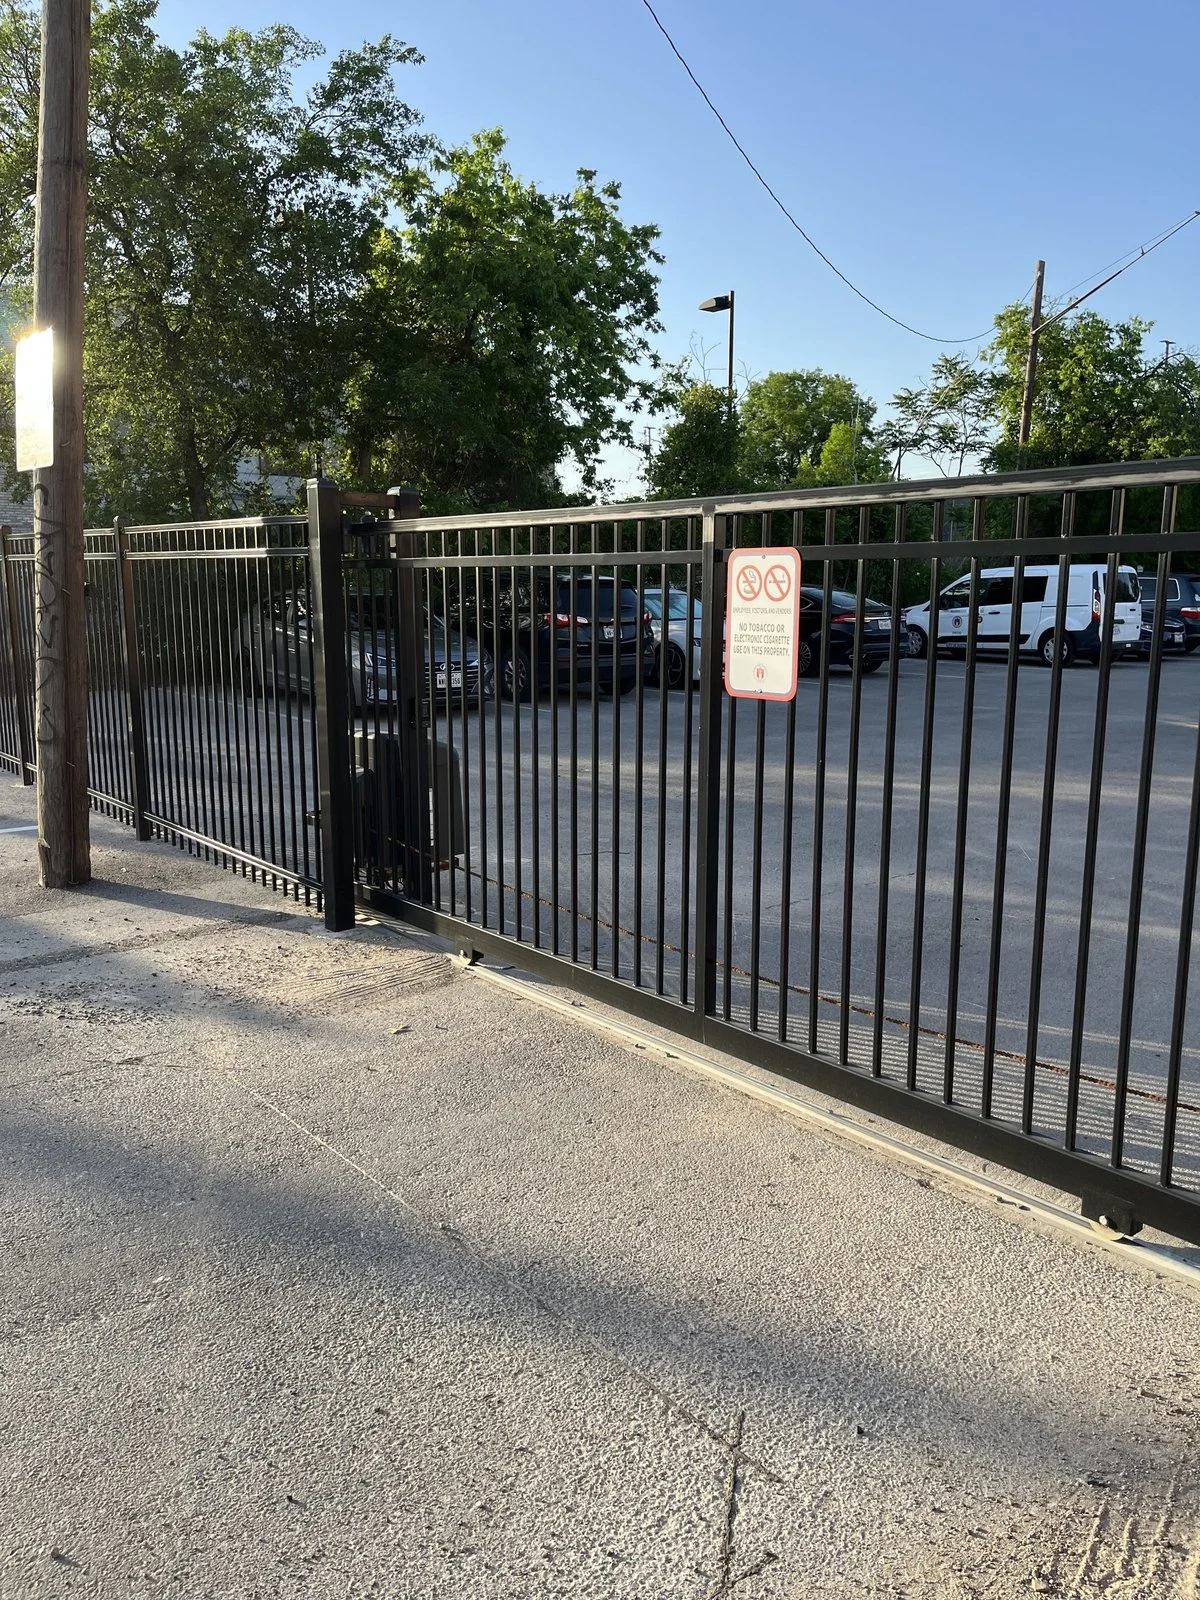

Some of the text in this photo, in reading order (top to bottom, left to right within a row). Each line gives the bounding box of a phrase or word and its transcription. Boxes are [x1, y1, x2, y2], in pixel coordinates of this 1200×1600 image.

[739, 622, 785, 633] NO TOBACCO OR
[734, 634, 790, 645] ELECTRONIC CIGARETTE
[734, 645, 791, 656] USE ON THIS PROPERTY.
